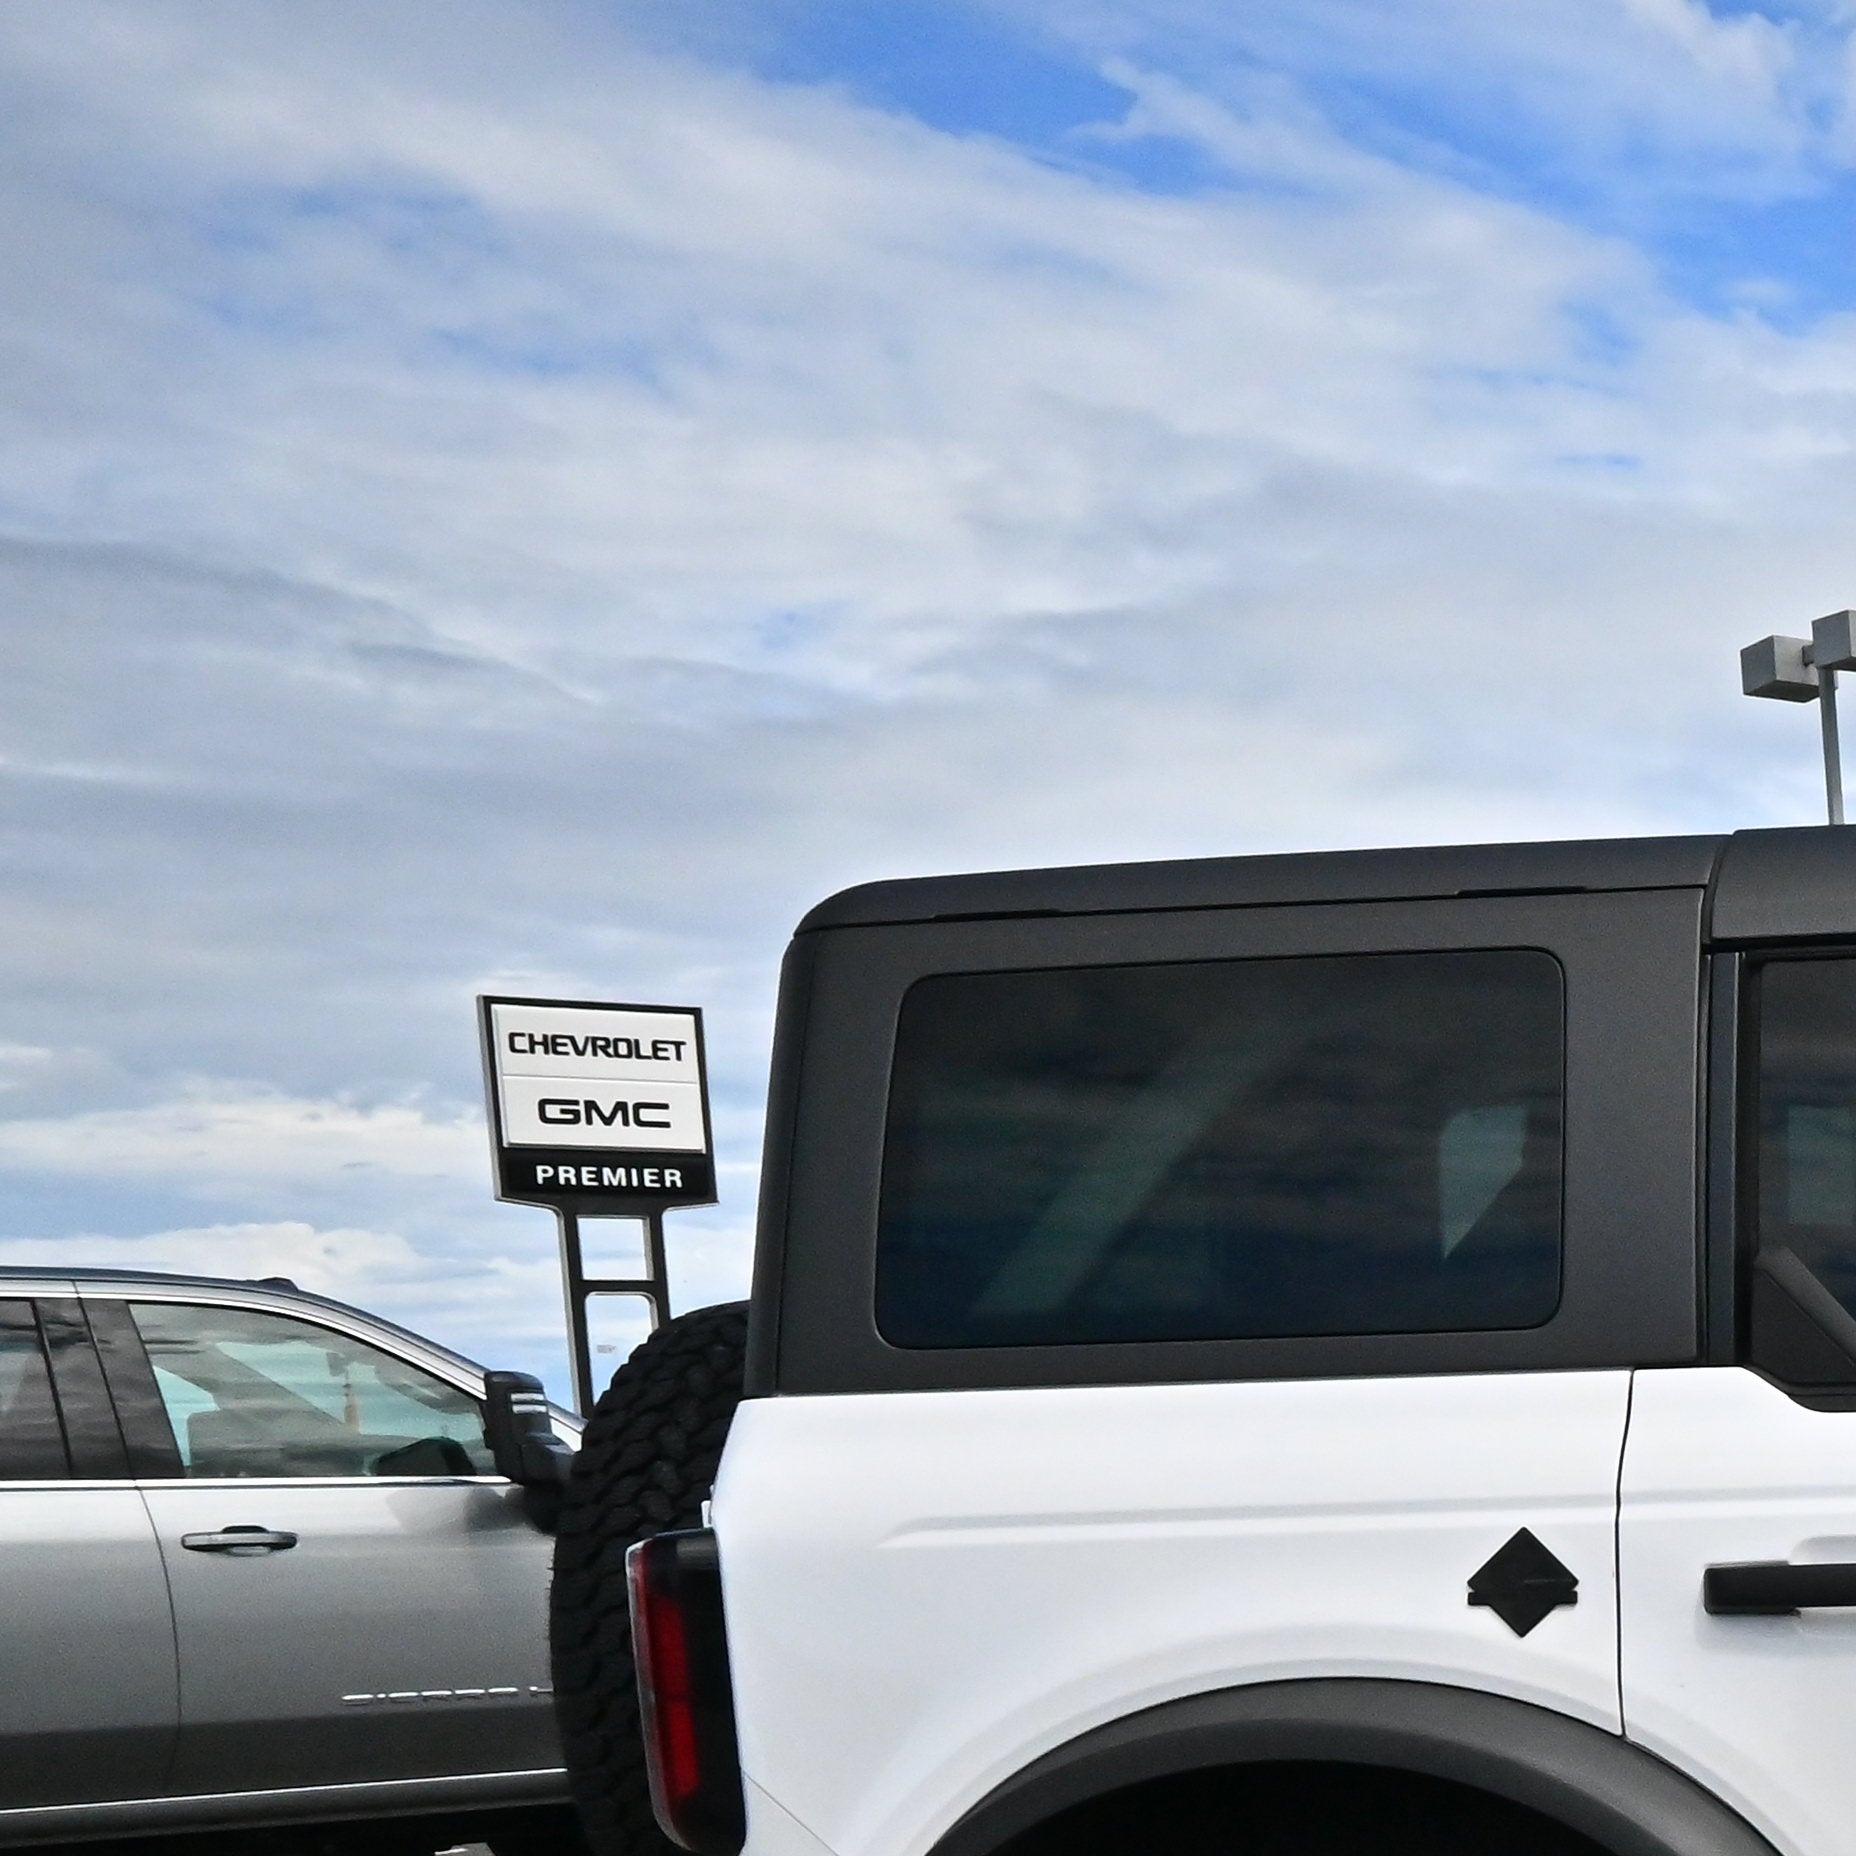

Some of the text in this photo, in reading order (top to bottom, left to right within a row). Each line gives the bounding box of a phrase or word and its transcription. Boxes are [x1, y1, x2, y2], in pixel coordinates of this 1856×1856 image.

[508, 1031, 687, 1061] CHEVROLET
[538, 1098, 672, 1129] GMC
[535, 1164, 683, 1188] PREMIER
